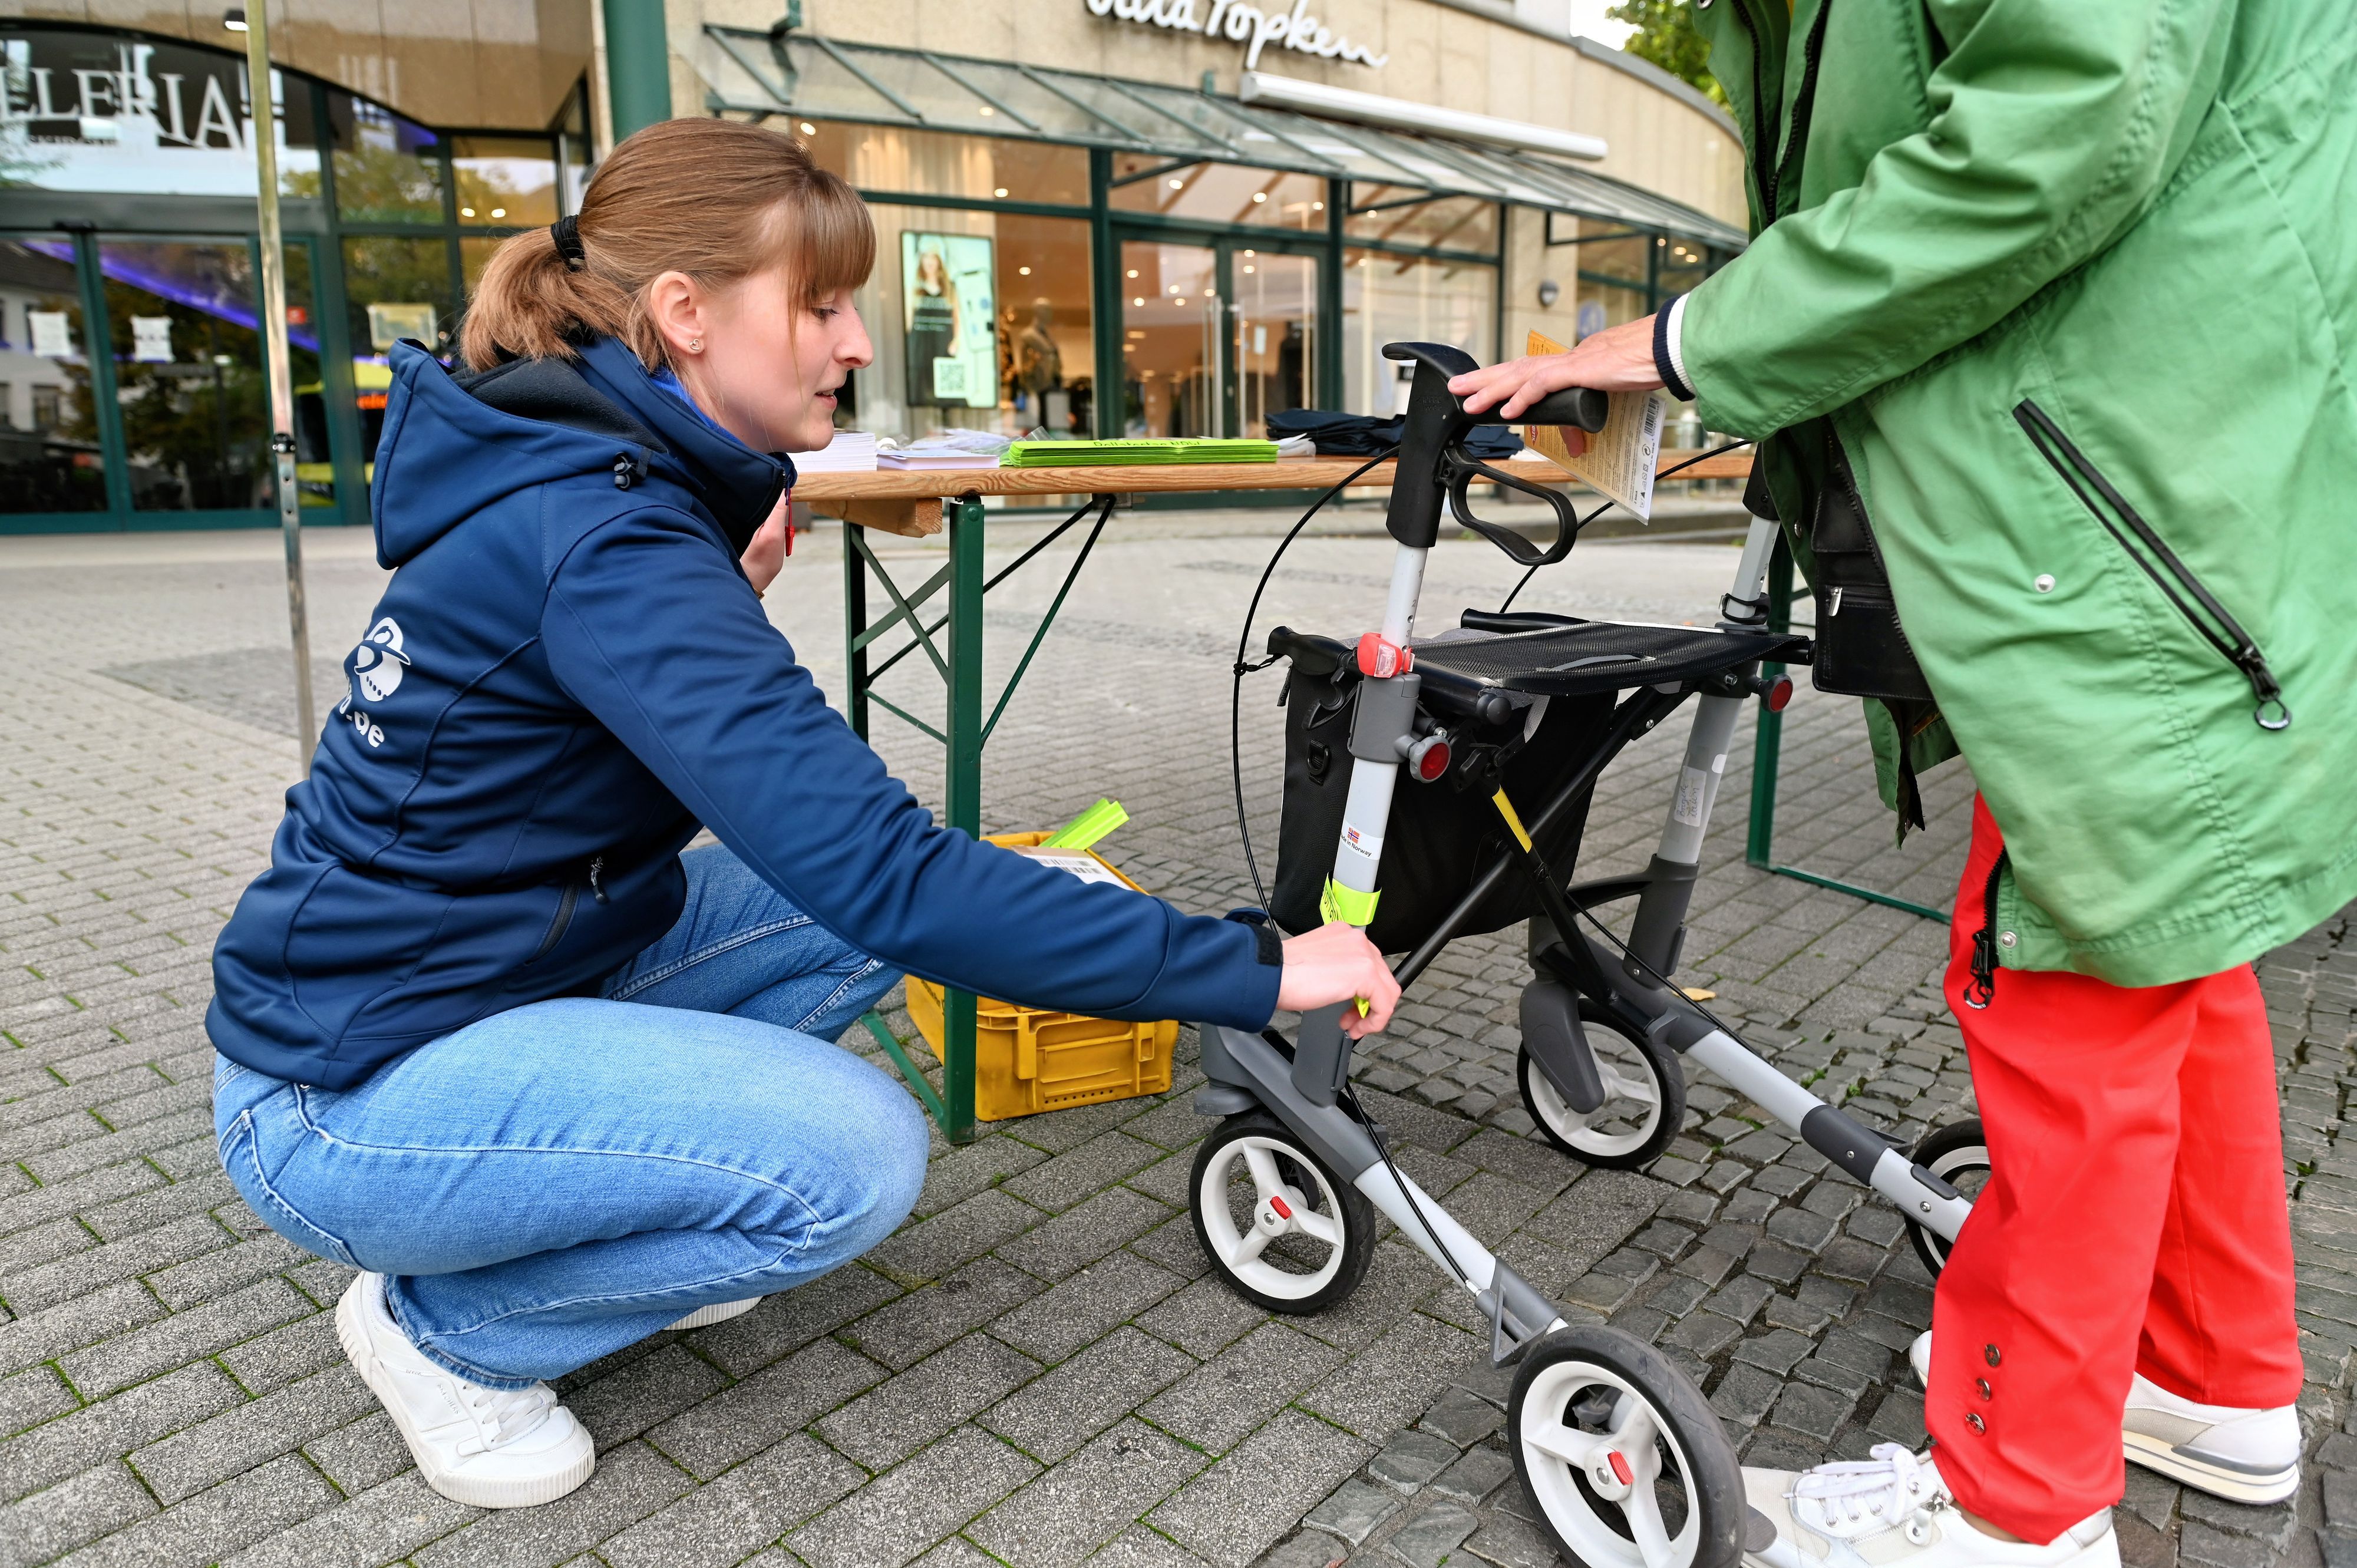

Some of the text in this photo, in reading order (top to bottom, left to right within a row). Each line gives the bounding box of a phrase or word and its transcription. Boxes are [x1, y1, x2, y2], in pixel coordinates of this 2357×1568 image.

[1418, 569, 1422, 577] 1
[1411, 599, 1417, 608] 2
[1405, 629, 1411, 638] 3
[1352, 844, 1372, 857] Norway
